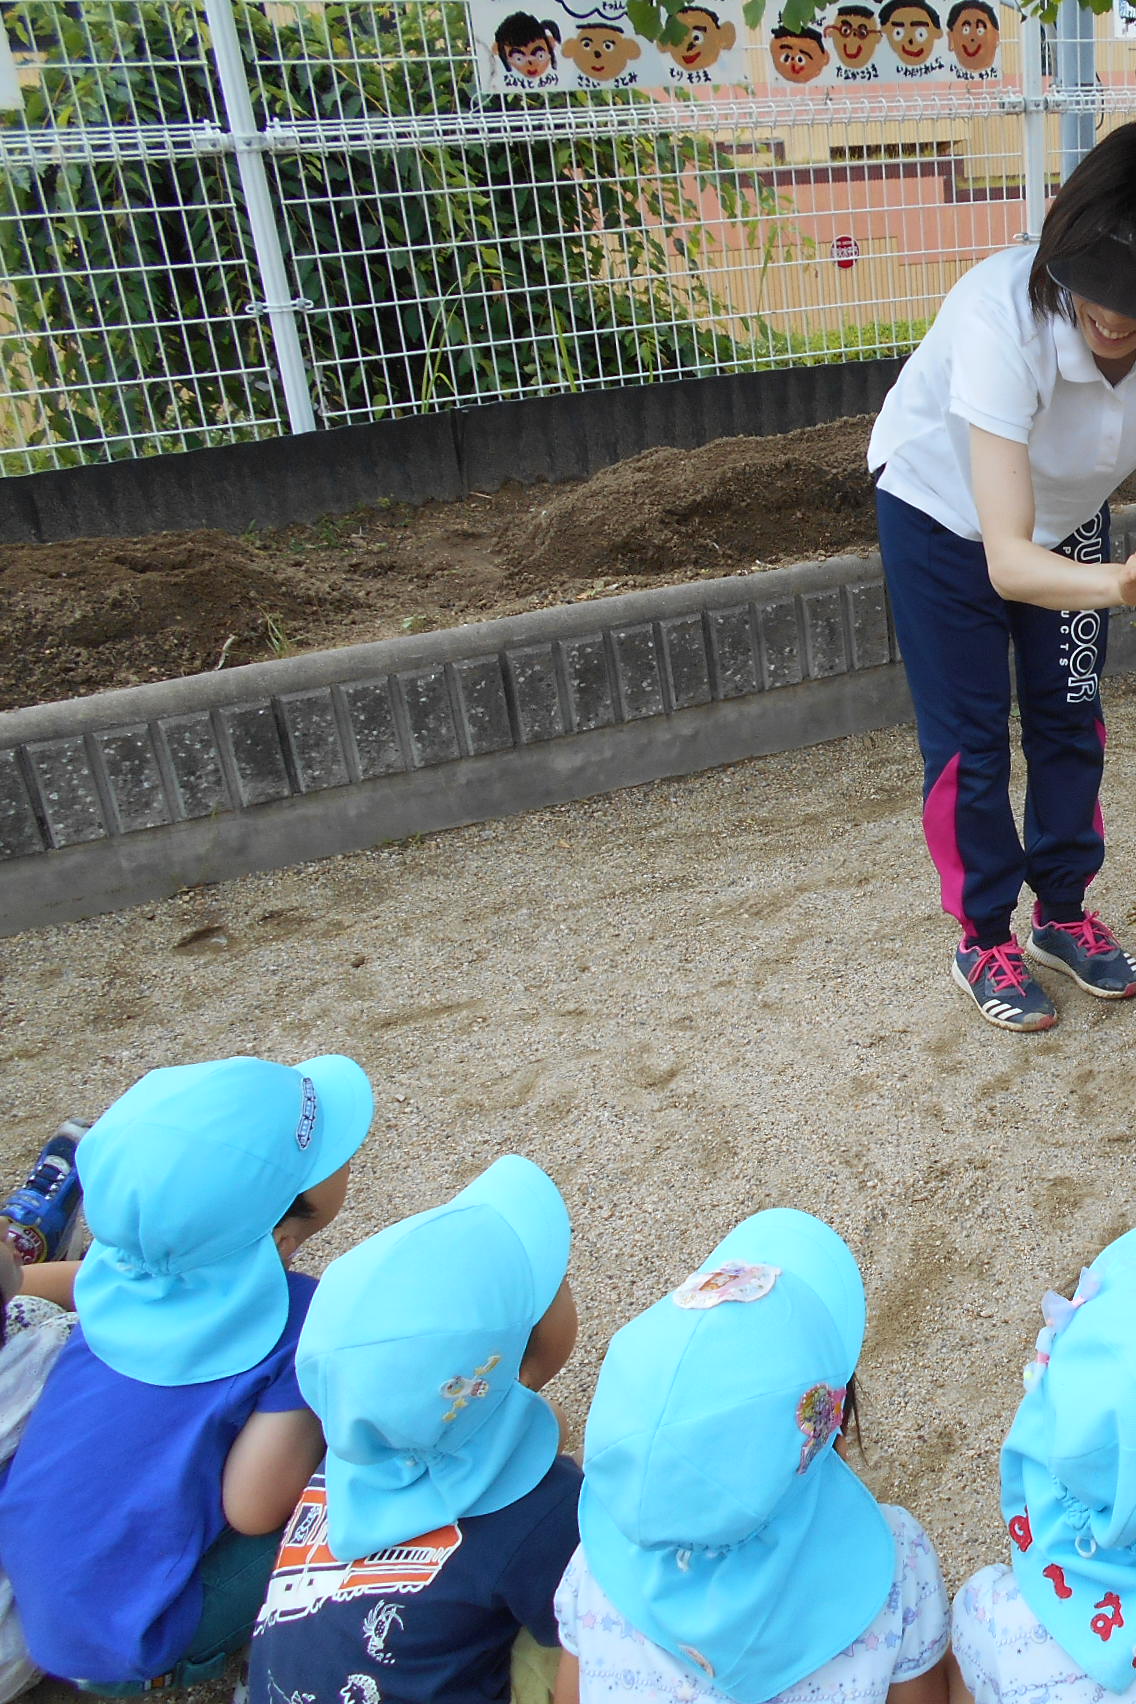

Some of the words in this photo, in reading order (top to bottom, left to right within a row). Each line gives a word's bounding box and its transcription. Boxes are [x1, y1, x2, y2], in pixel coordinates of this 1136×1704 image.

[614, 71, 638, 88] さとみ
[670, 67, 683, 81] もり
[687, 69, 712, 84] そうま
[835, 63, 880, 80] たなかこうき
[1059, 546, 1072, 667] PUCTS
[1066, 511, 1103, 703] OUOOR
